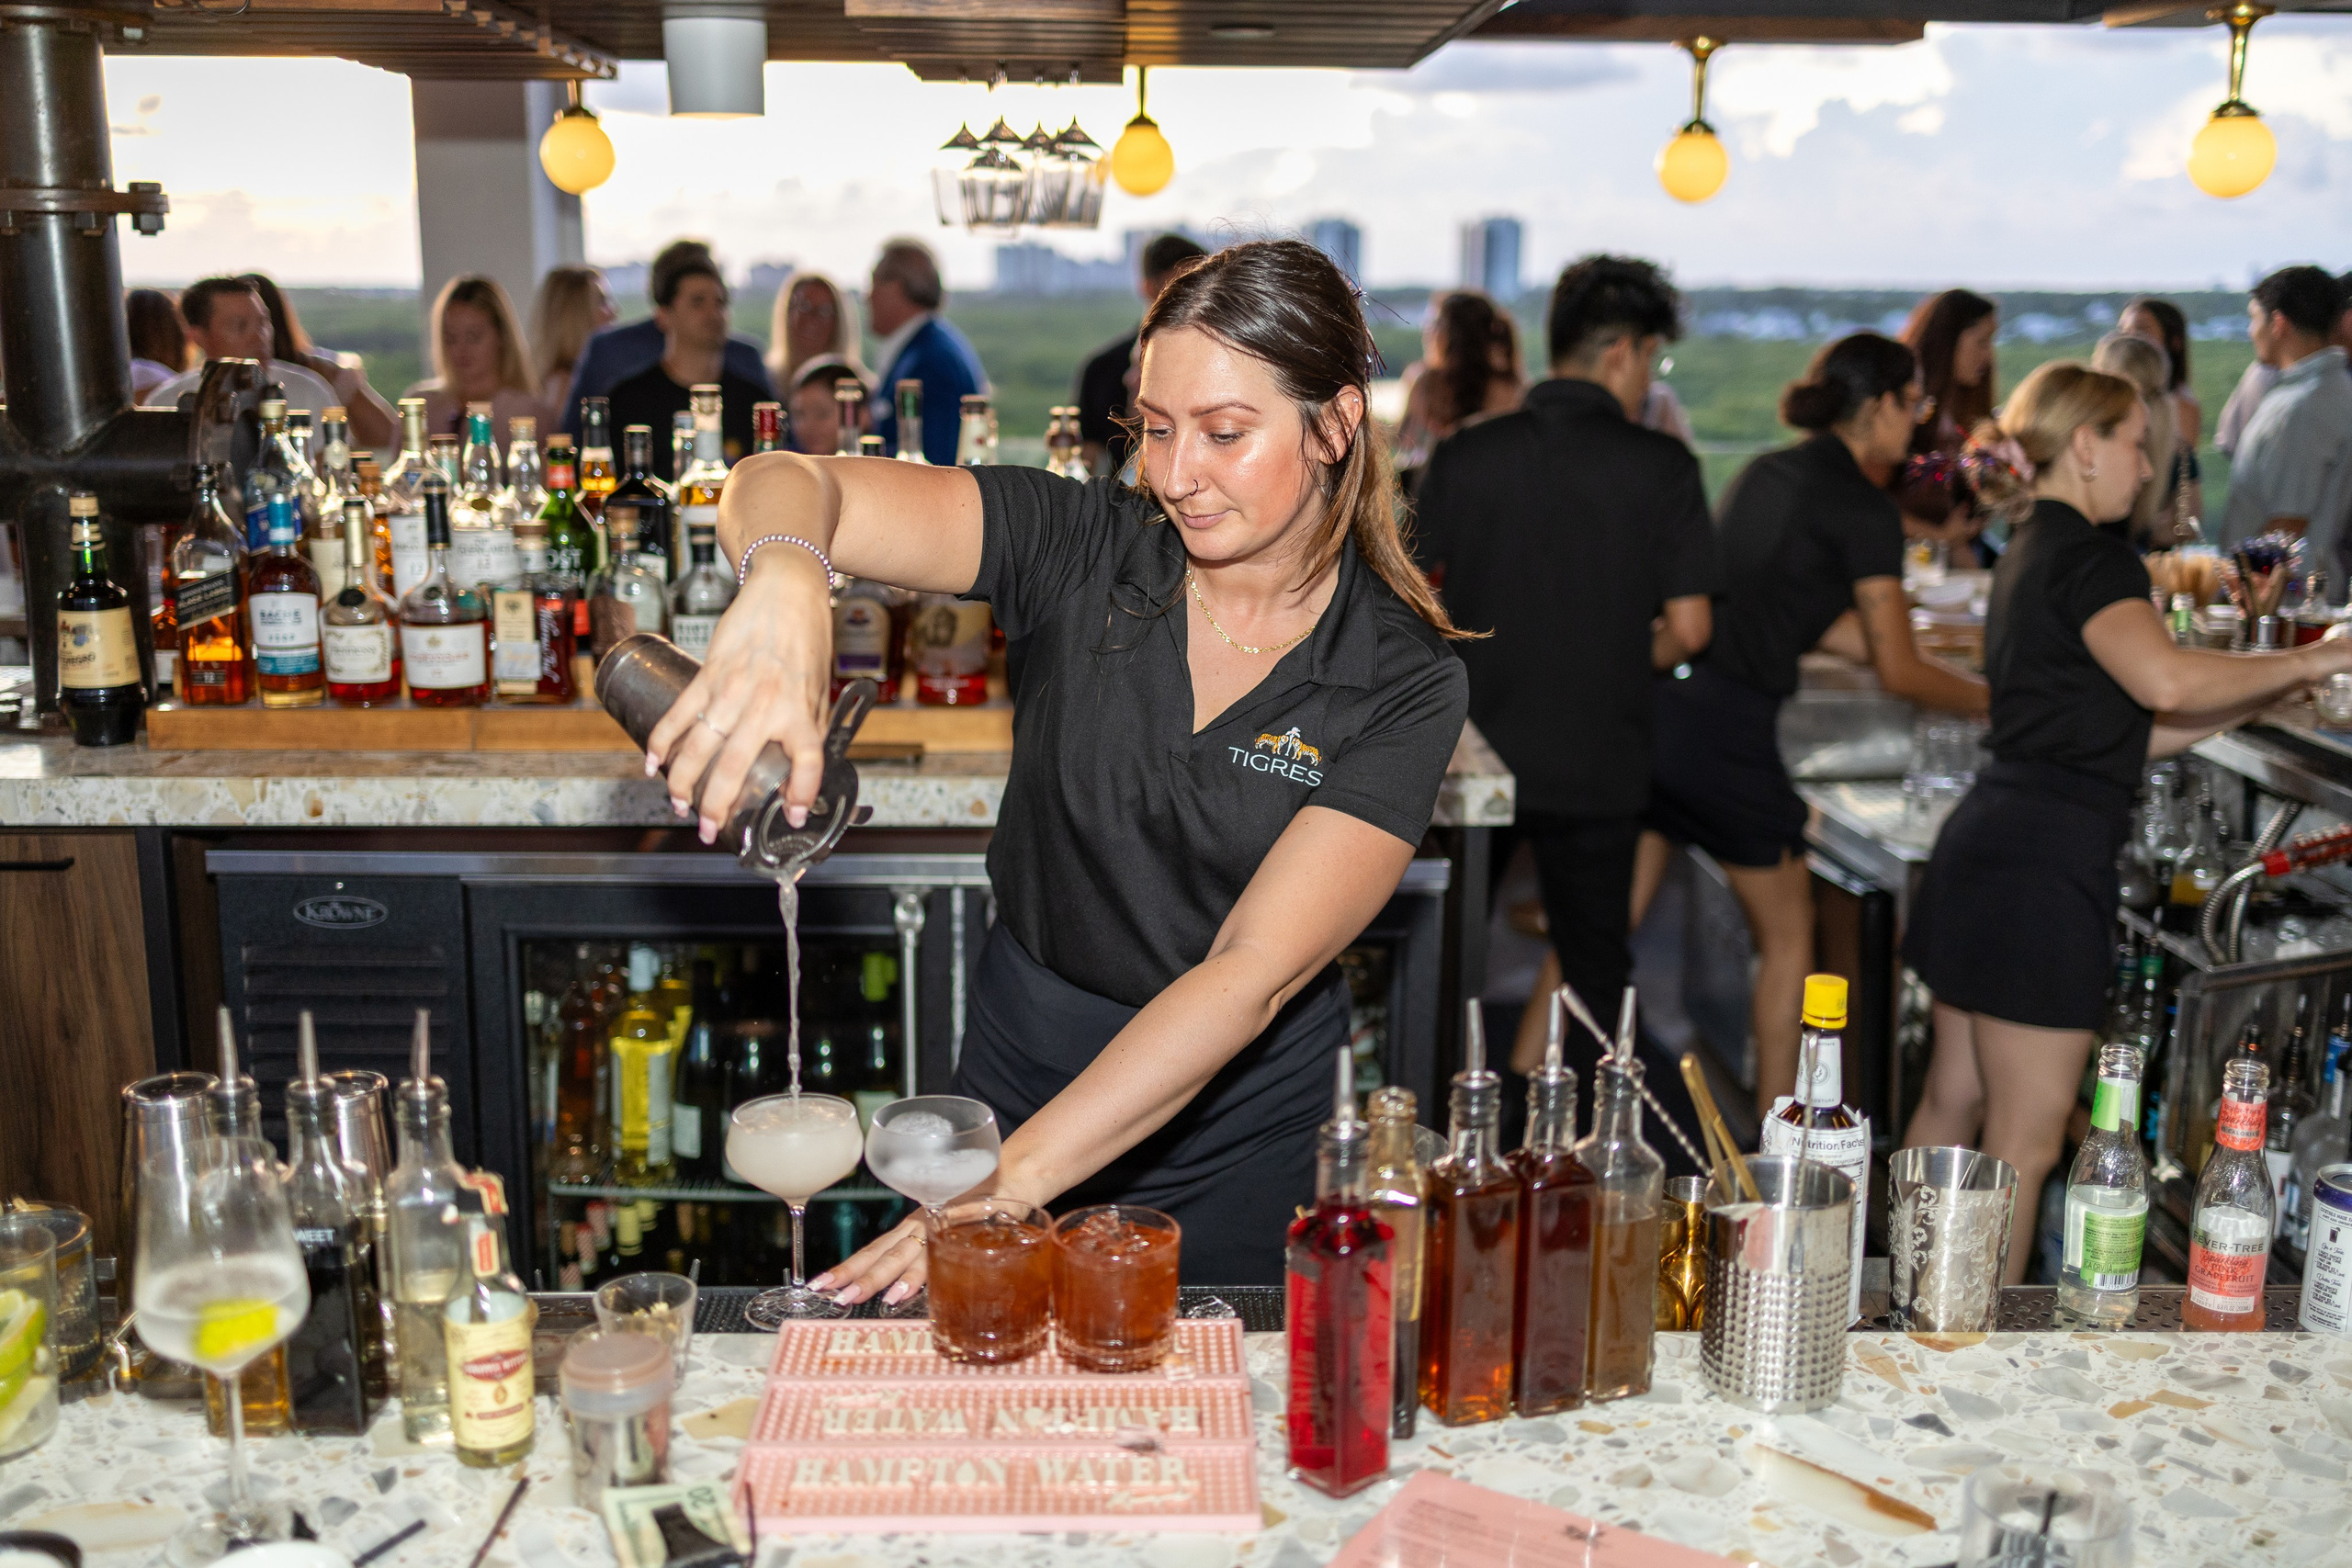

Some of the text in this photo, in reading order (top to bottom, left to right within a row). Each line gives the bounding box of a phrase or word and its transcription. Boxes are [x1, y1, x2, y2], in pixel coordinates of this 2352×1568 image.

[546, 547, 582, 569] OST
[1228, 746, 1324, 787] TIGRES
[1792, 1136, 1839, 1151] Ntrition
[291, 1228, 336, 1242] WEET
[2192, 1230, 2264, 1253] FEVER-TREE
[2202, 1254, 2249, 1268] Sparkling
[2211, 1263, 2237, 1274] PINK
[2194, 1265, 2256, 1283] GRAPEFRUIT
[818, 1407, 967, 1433] WATER
[790, 1455, 1199, 1488] HAMPTON WATER
